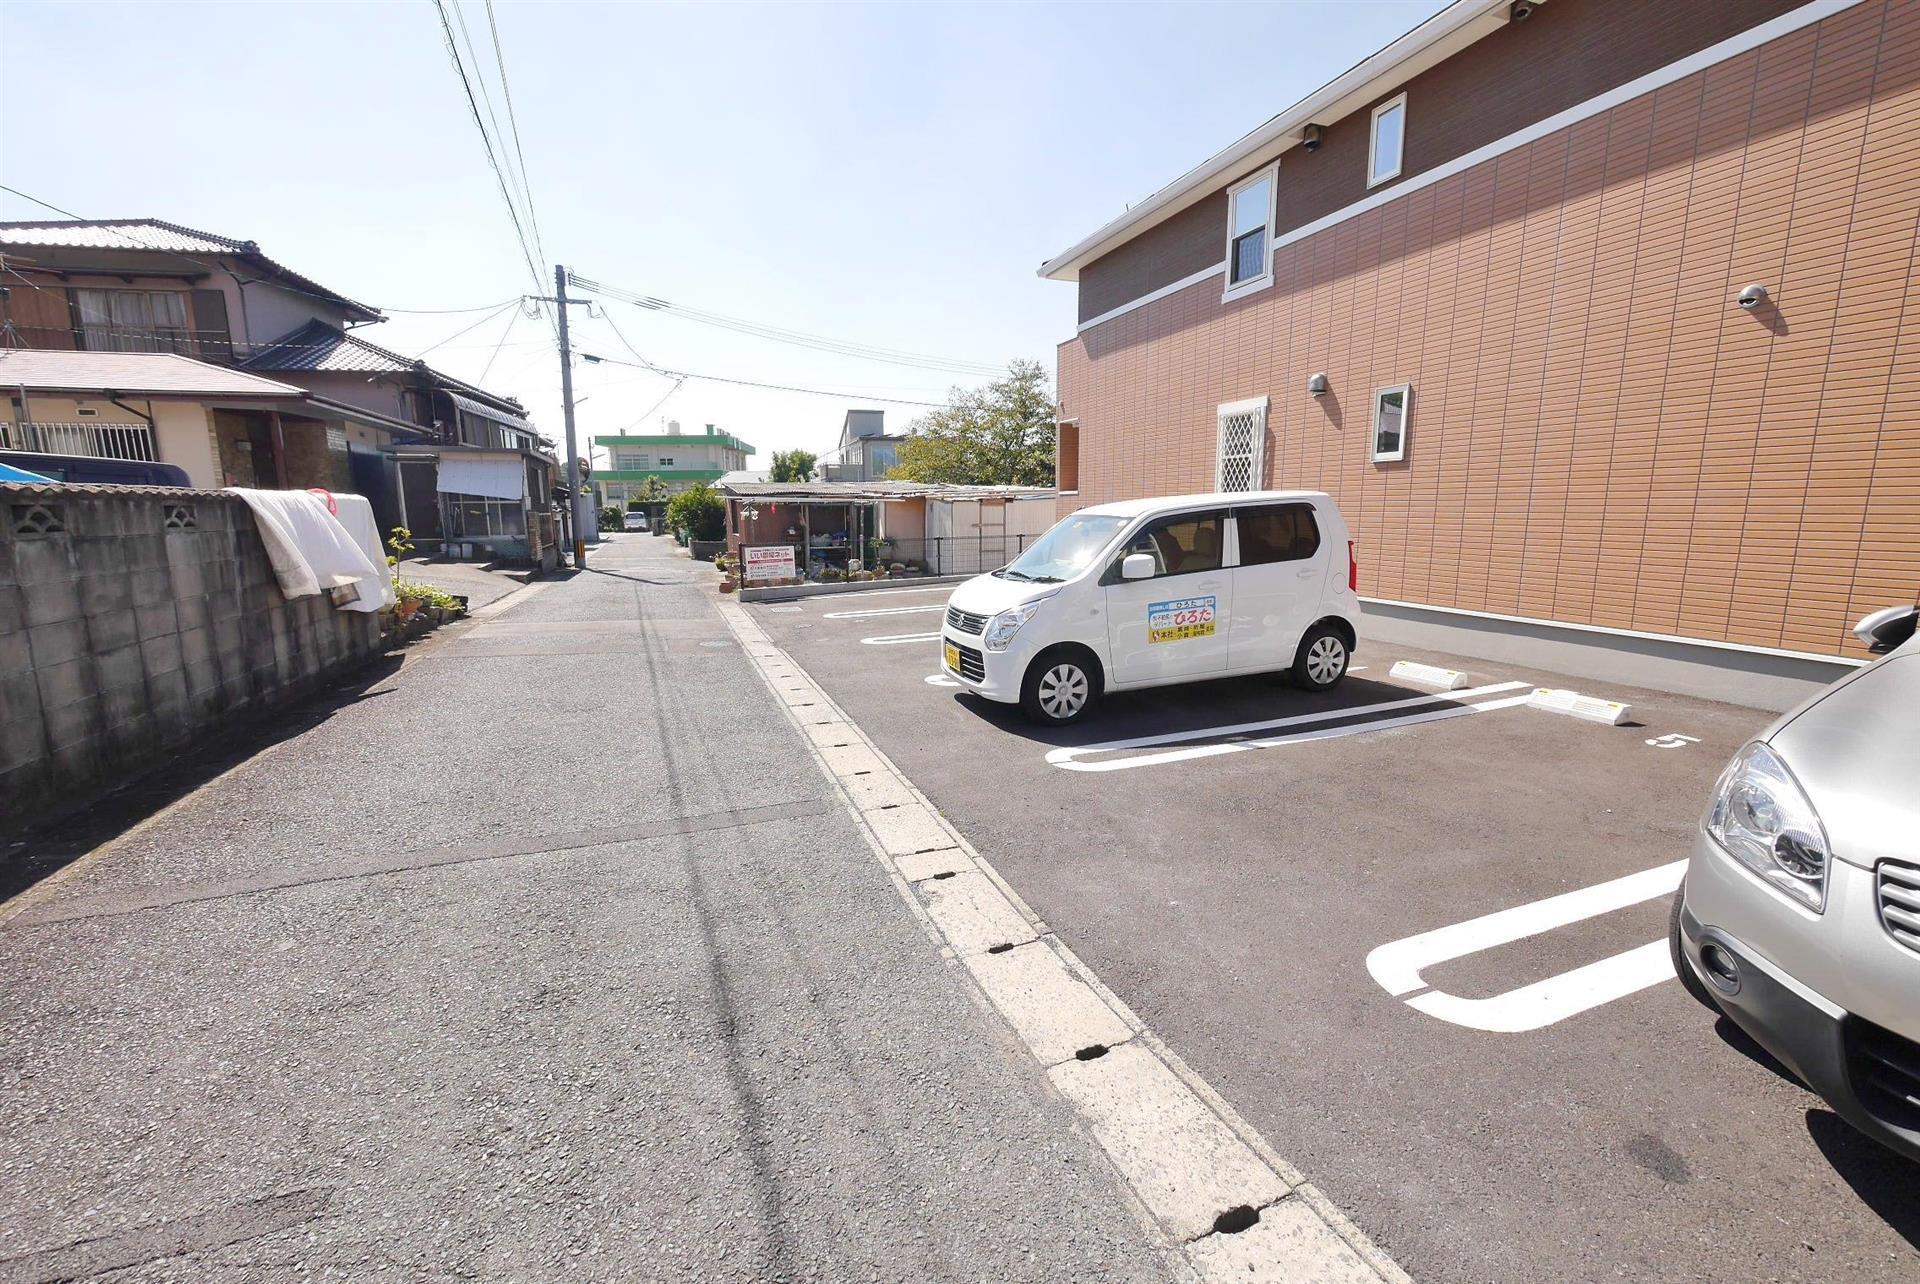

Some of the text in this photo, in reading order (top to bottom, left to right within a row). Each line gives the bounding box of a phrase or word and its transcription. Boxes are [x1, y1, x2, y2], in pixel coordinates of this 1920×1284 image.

[1176, 600, 1198, 609] ひろた
[1173, 608, 1212, 625] ひろた
[1645, 733, 1702, 749] 5
